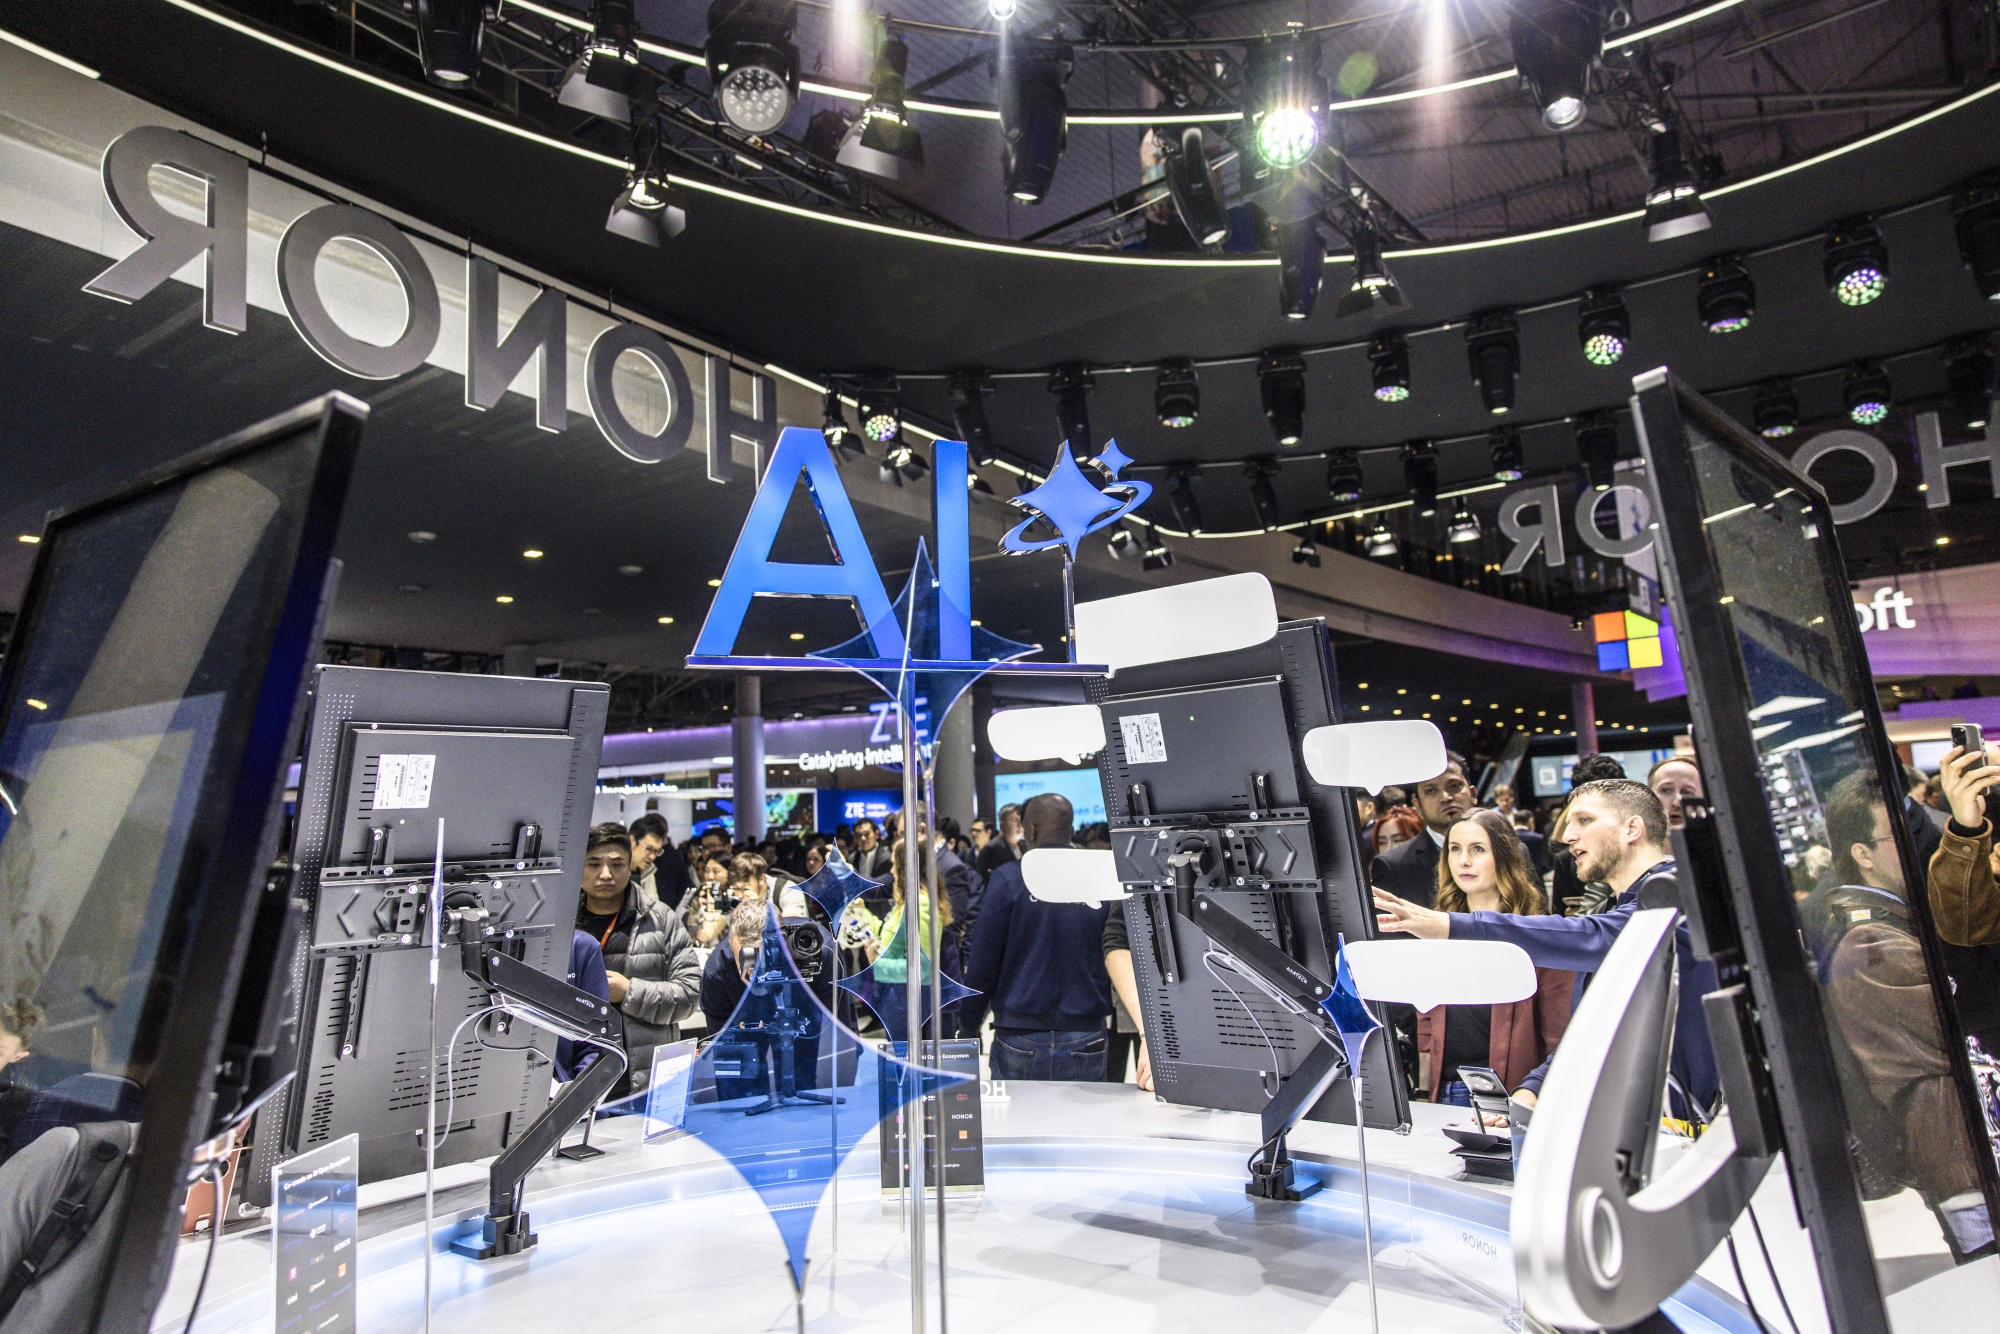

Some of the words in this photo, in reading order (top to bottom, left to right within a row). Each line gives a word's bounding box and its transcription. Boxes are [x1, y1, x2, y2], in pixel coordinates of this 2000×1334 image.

[693, 426, 972, 661] AI
[1853, 586, 1917, 633] oft
[799, 749, 865, 773] Catalyzing
[845, 802, 866, 819] ZTE
